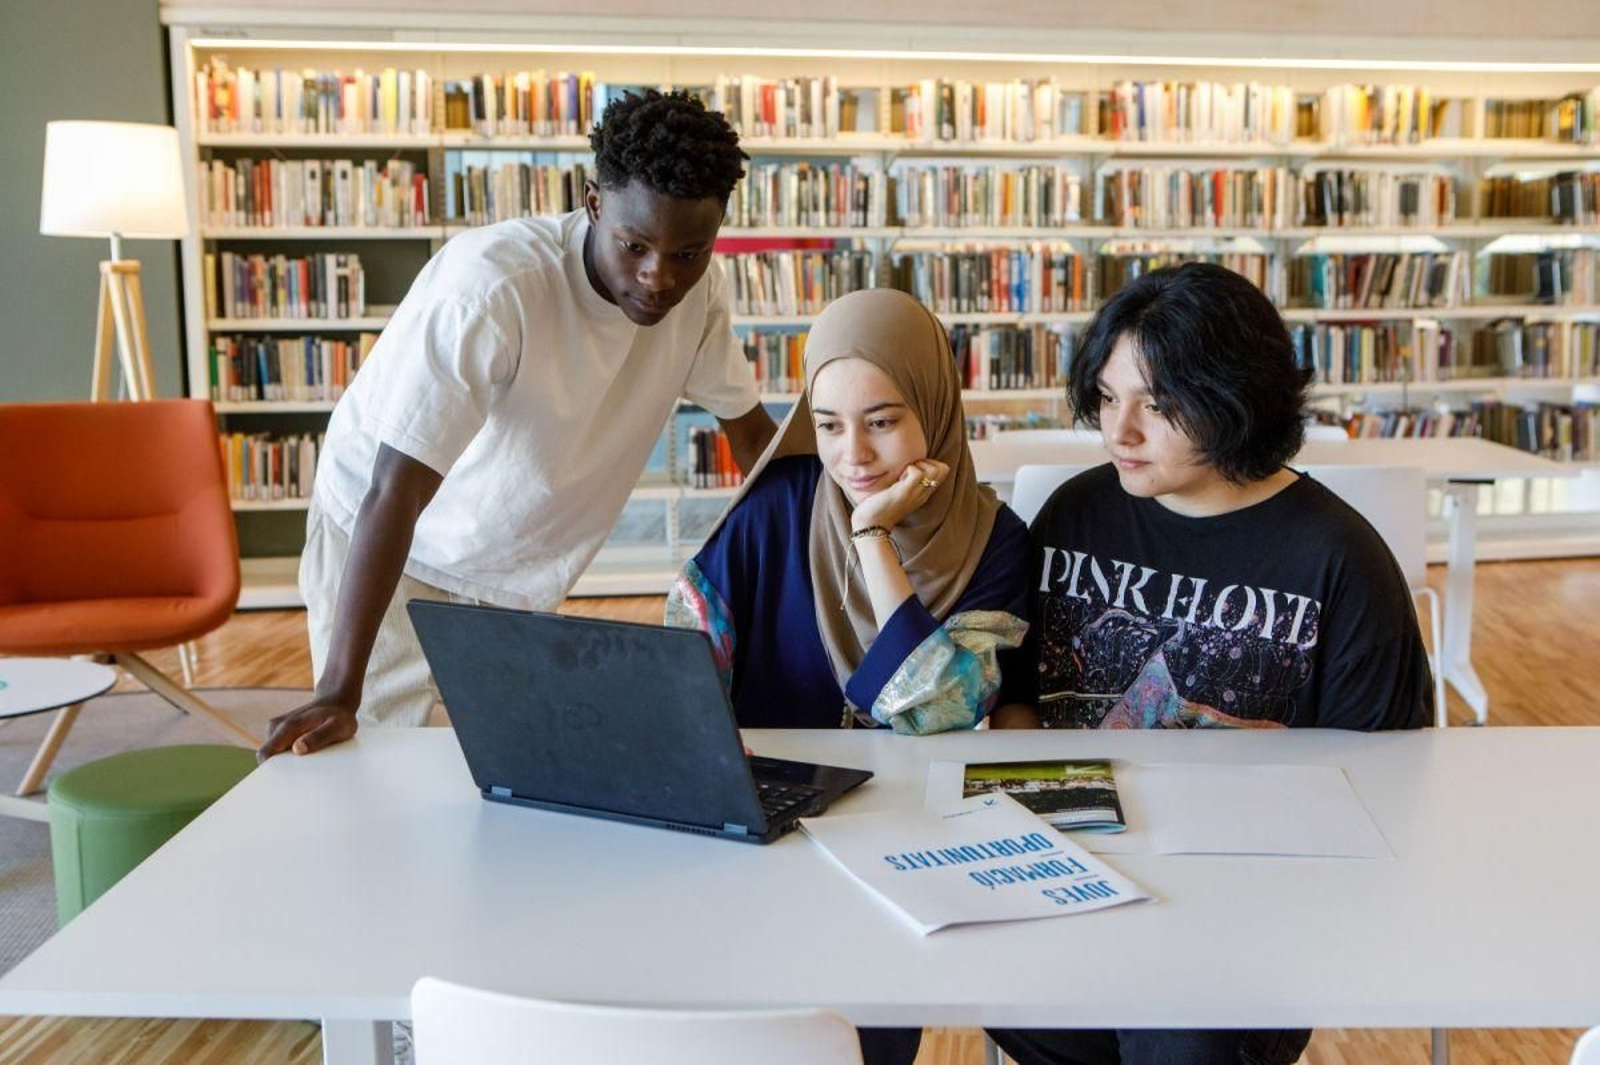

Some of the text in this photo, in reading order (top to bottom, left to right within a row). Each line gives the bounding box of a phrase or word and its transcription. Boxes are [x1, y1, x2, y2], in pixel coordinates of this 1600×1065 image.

[1039, 547, 1158, 615] PINK
[884, 833, 1054, 870] OPORTUNITATS
[969, 855, 1089, 889] FORMACIÓ
[1042, 881, 1120, 905] JOVES
